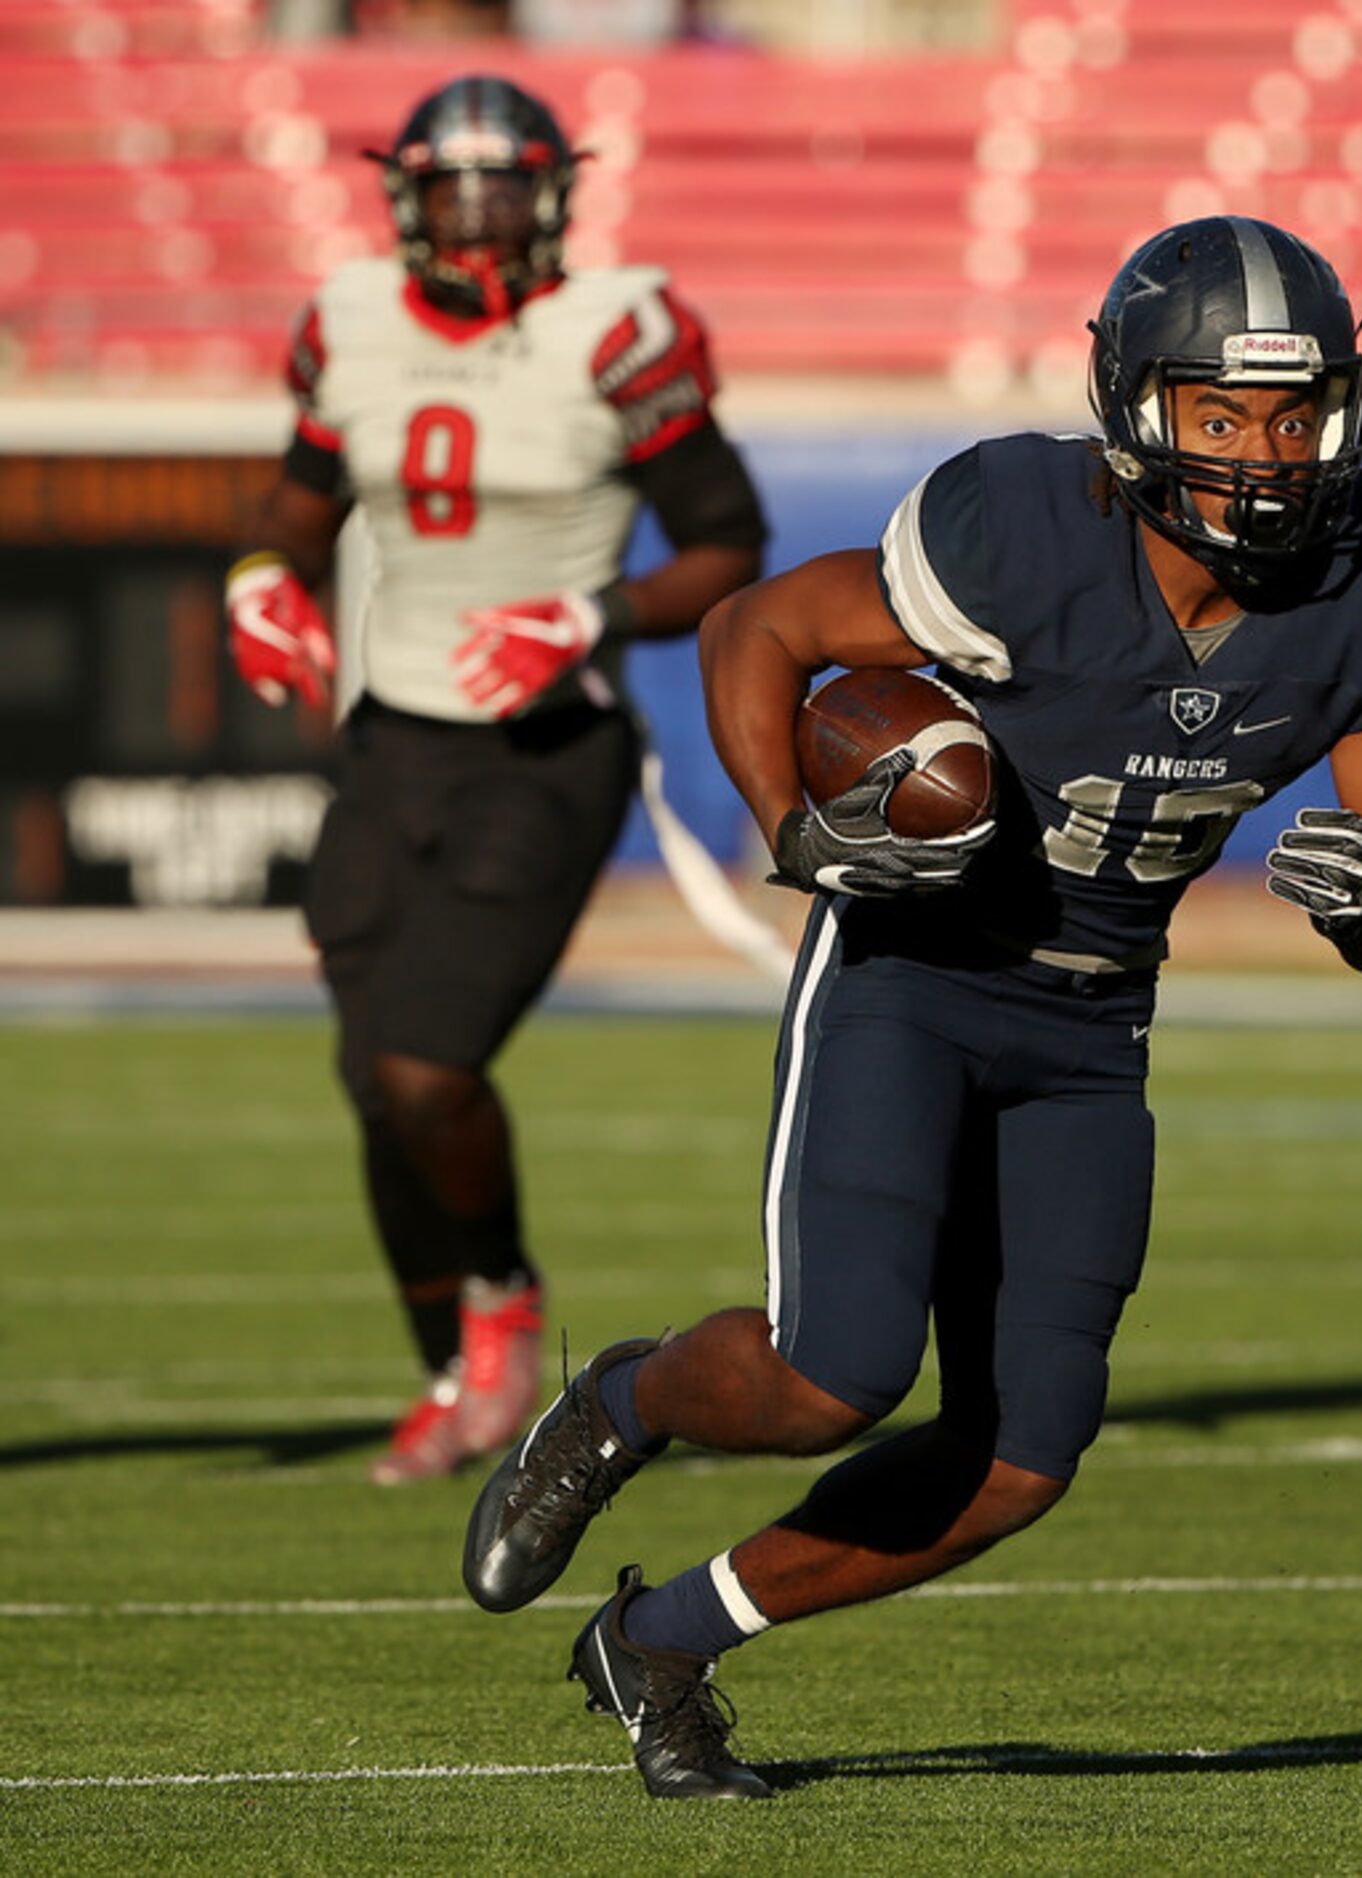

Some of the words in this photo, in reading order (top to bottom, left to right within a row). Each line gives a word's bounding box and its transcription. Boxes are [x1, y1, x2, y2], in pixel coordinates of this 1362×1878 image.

[1243, 337, 1297, 353] Riddell
[402, 403, 476, 540] 8
[1124, 753, 1229, 780] RANGERS
[1042, 773, 1265, 884] 10
